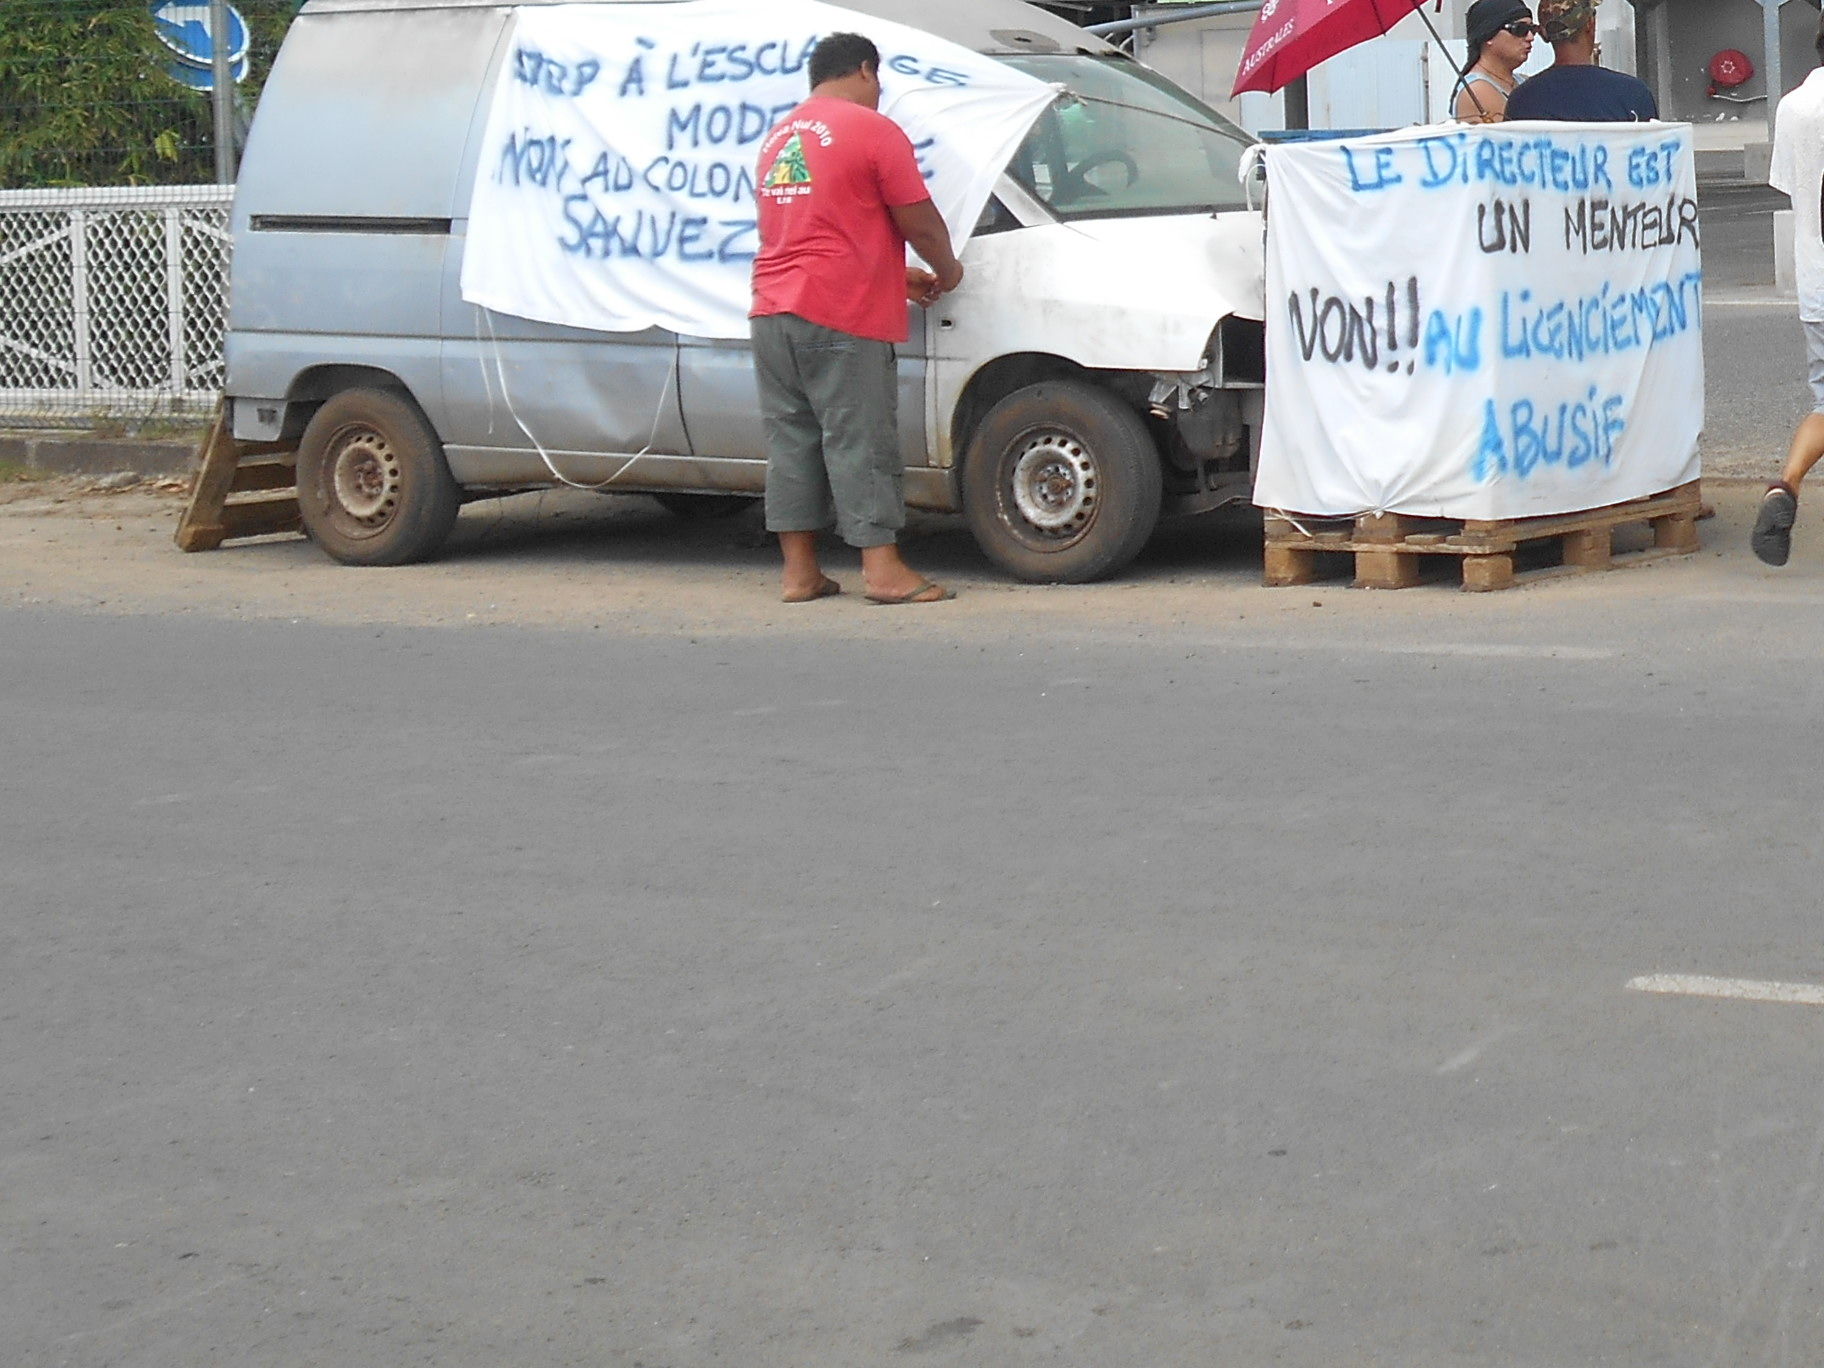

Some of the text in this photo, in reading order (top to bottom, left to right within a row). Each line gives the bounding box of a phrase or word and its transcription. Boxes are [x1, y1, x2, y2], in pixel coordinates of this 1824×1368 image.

[810, 121, 832, 147] 2010
[1340, 145, 1402, 192] LE
[1627, 140, 1681, 190] EST
[1477, 192, 1699, 255] UN MENTEUR
[1423, 304, 1483, 376] AU
